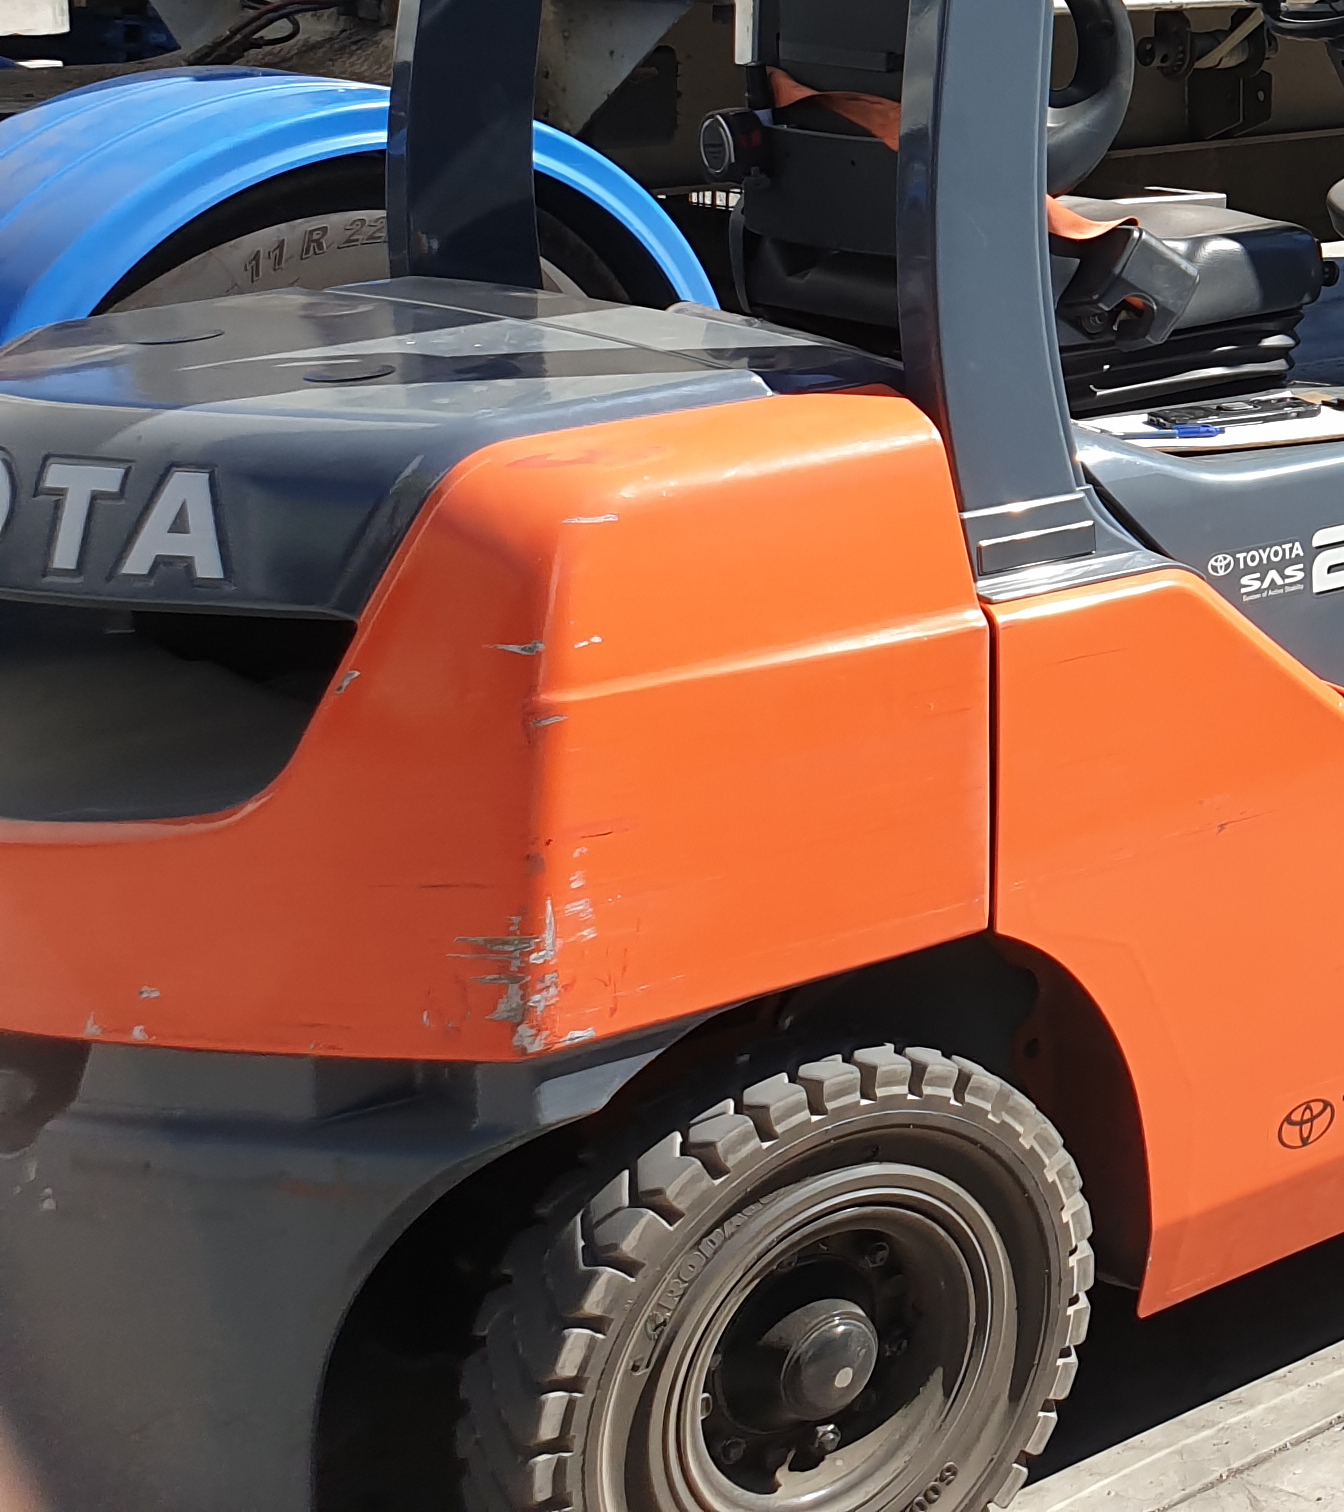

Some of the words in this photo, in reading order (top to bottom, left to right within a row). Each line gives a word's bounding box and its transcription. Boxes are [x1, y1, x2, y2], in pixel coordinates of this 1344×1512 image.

[244, 238, 286, 283] 11
[301, 224, 328, 259] R
[1236, 541, 1304, 570] TOYOTA
[1240, 563, 1305, 594] SAS
